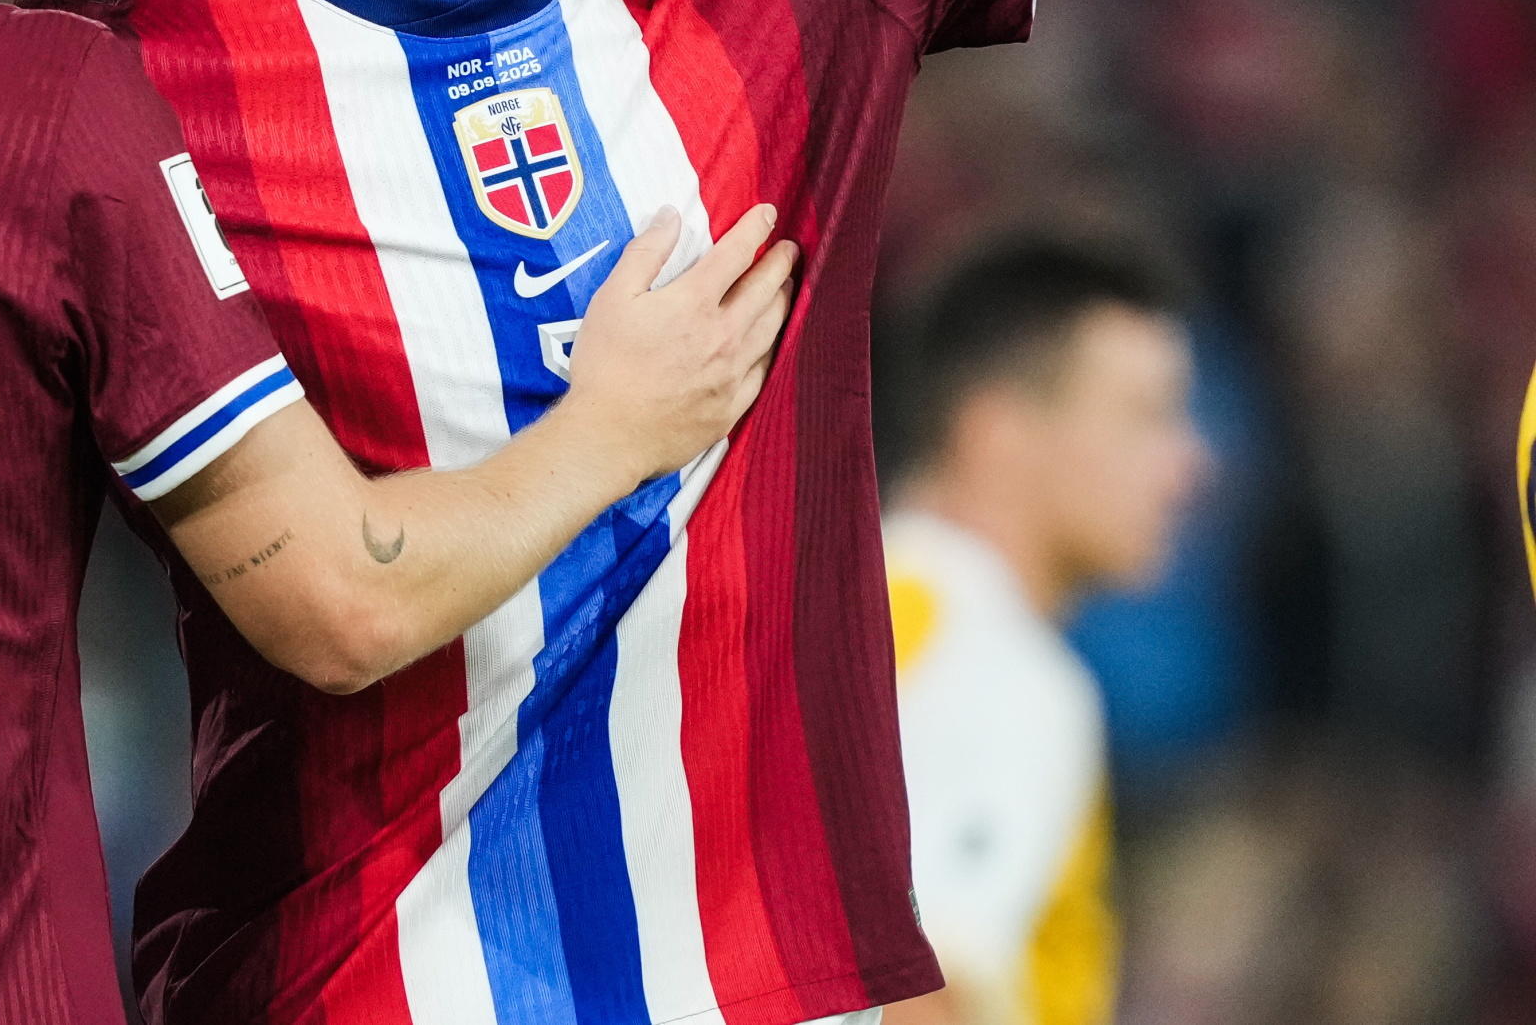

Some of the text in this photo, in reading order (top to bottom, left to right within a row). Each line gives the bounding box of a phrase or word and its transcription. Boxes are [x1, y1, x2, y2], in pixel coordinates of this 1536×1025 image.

[447, 58, 483, 79] NOR
[495, 46, 535, 67] MDA
[448, 58, 542, 100] 09.09.2025
[487, 97, 522, 116] NORGE
